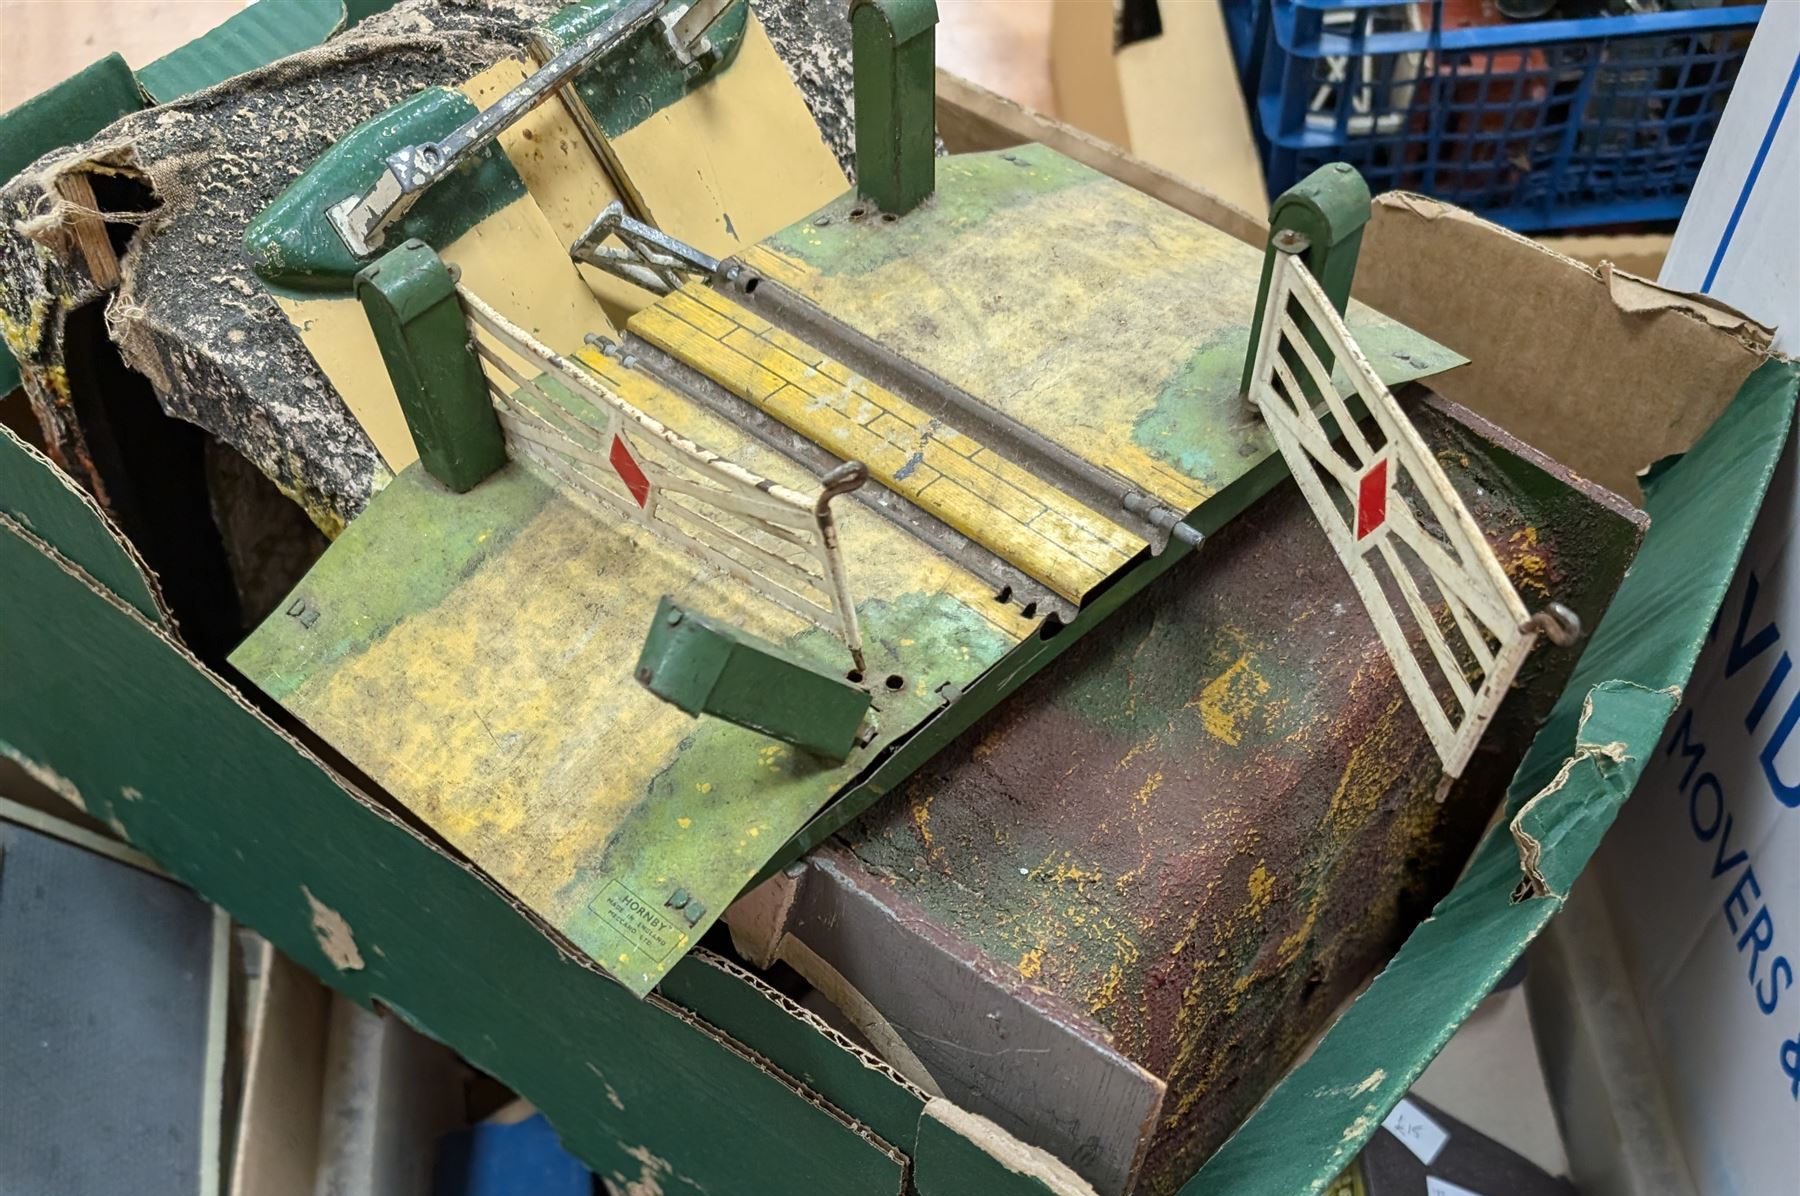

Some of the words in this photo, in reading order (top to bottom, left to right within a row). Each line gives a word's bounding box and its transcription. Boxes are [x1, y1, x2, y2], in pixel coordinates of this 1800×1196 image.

[1666, 707, 1793, 1016] MOVERS
[607, 898, 624, 913] MADE
[626, 913, 635, 921] IN
[637, 922, 666, 946] ENGLAND
[608, 910, 637, 934] MECCANO
[621, 895, 667, 931] HORNBY
